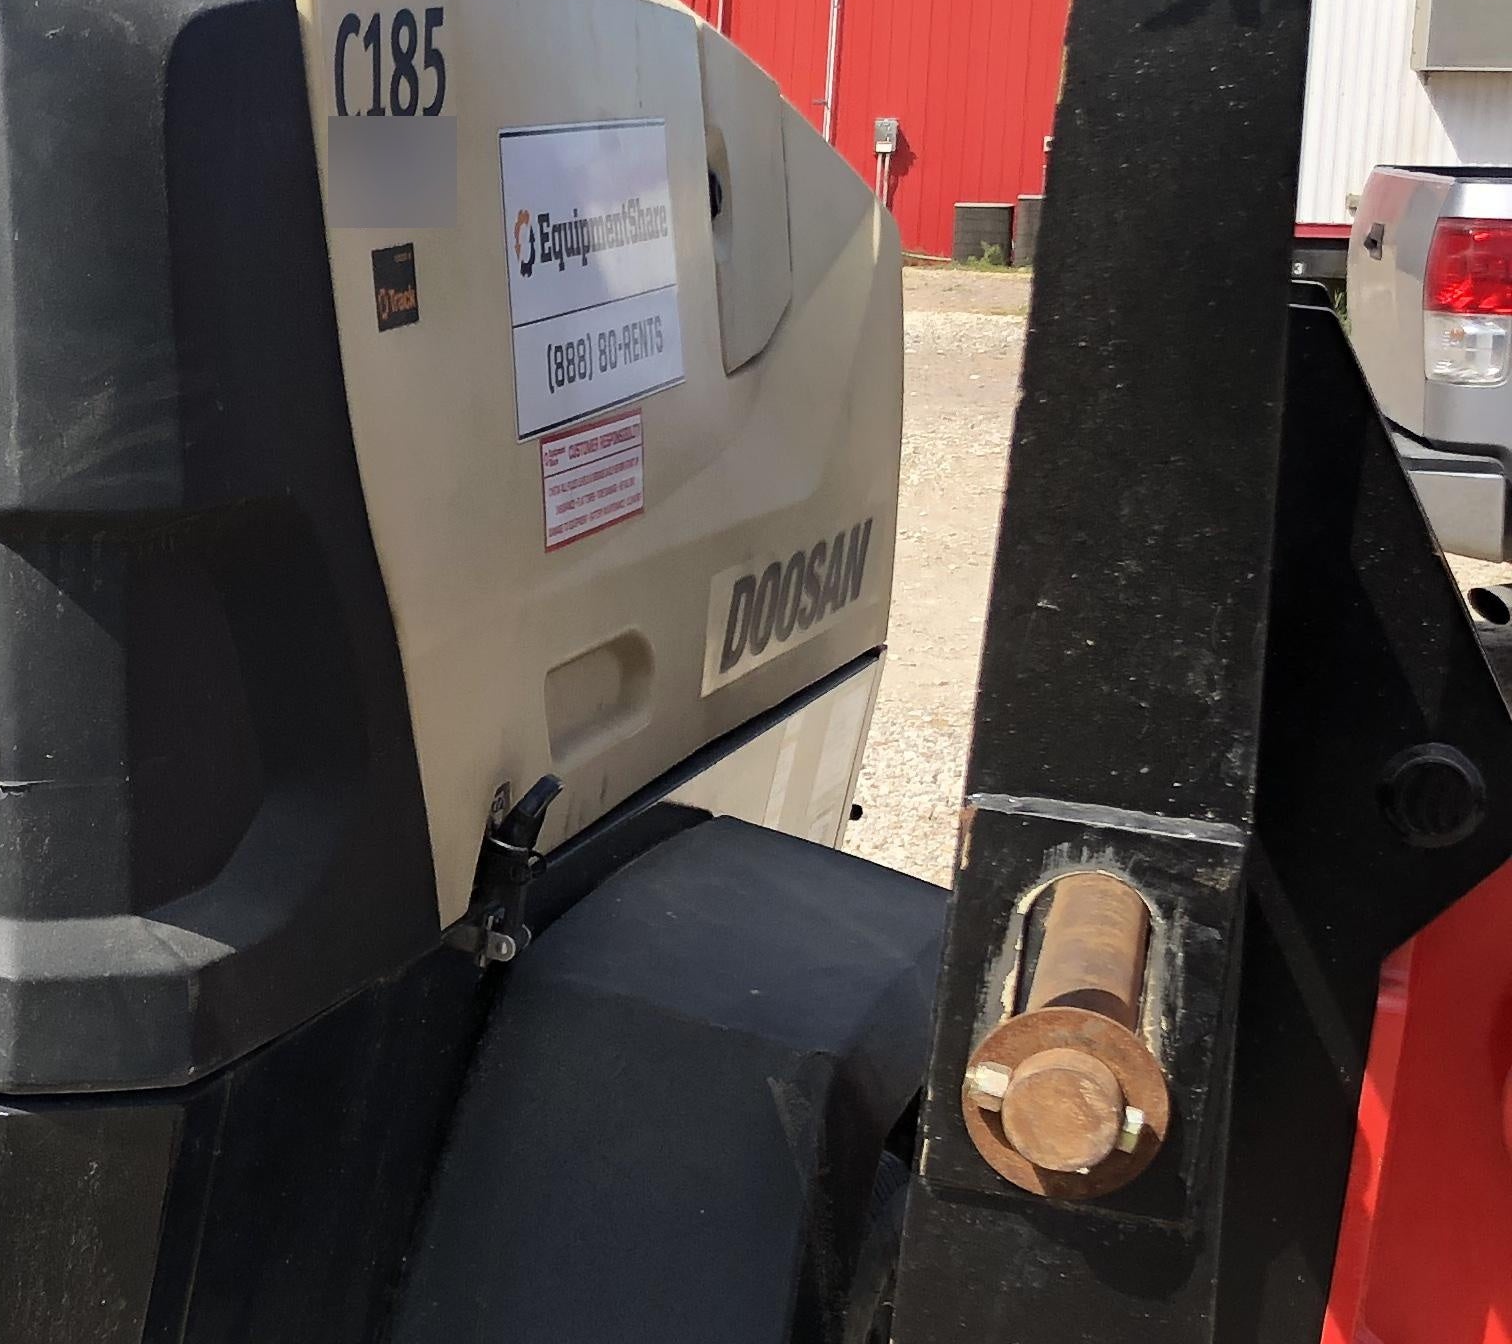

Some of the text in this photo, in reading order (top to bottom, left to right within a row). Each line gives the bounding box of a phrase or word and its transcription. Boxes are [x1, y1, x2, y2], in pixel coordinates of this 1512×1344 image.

[335, 7, 445, 116] C185
[538, 197, 668, 271] EquipmentShare
[547, 315, 664, 394] (888) 80-RENTS
[719, 517, 873, 674] DOOSAN
